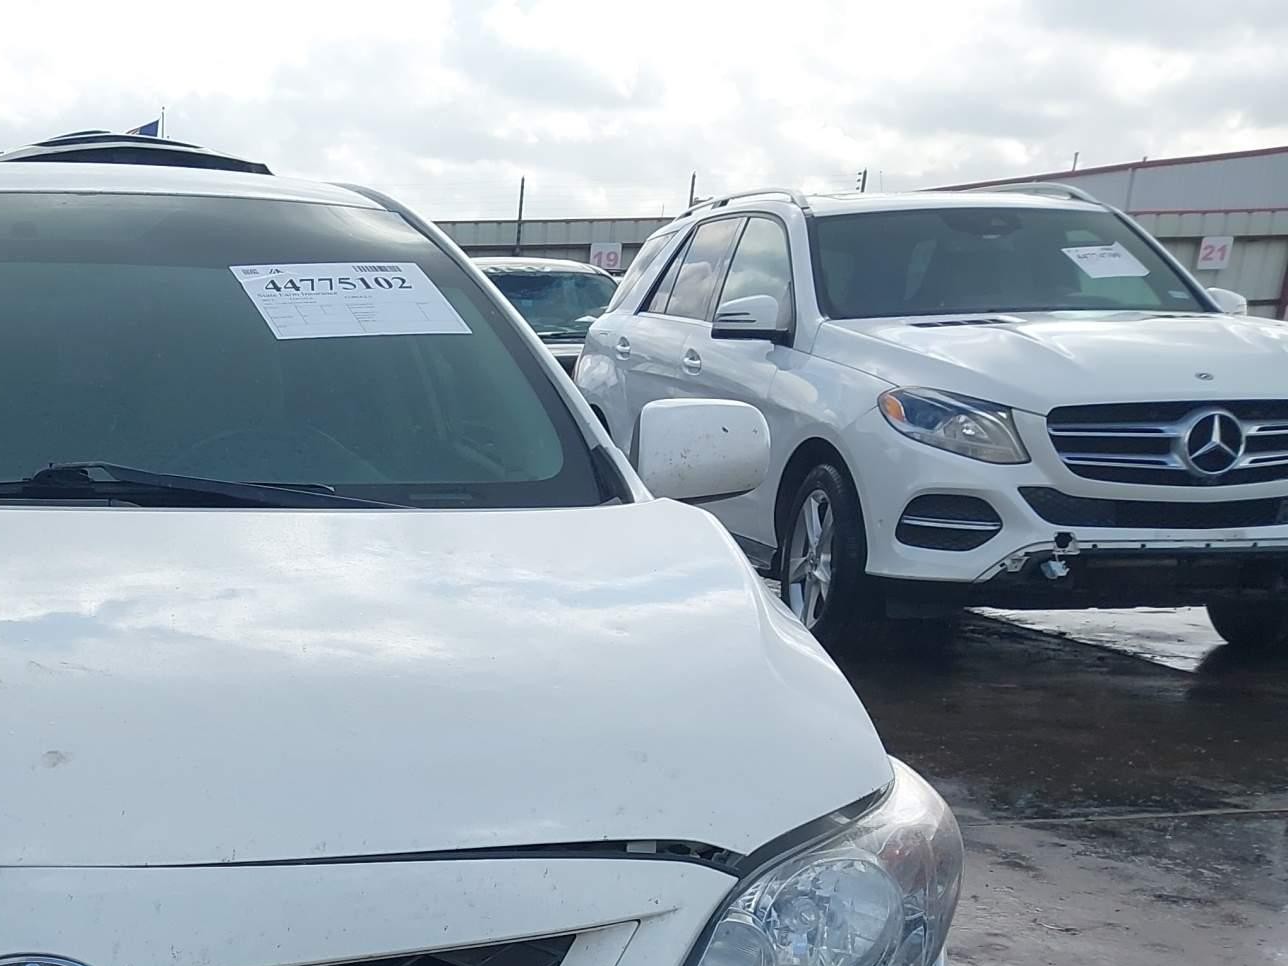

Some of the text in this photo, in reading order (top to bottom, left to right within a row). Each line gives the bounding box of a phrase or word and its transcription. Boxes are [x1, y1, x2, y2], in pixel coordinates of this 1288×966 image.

[592, 250, 619, 268] 19
[1201, 244, 1227, 262] 21
[264, 276, 413, 293] 44775102
